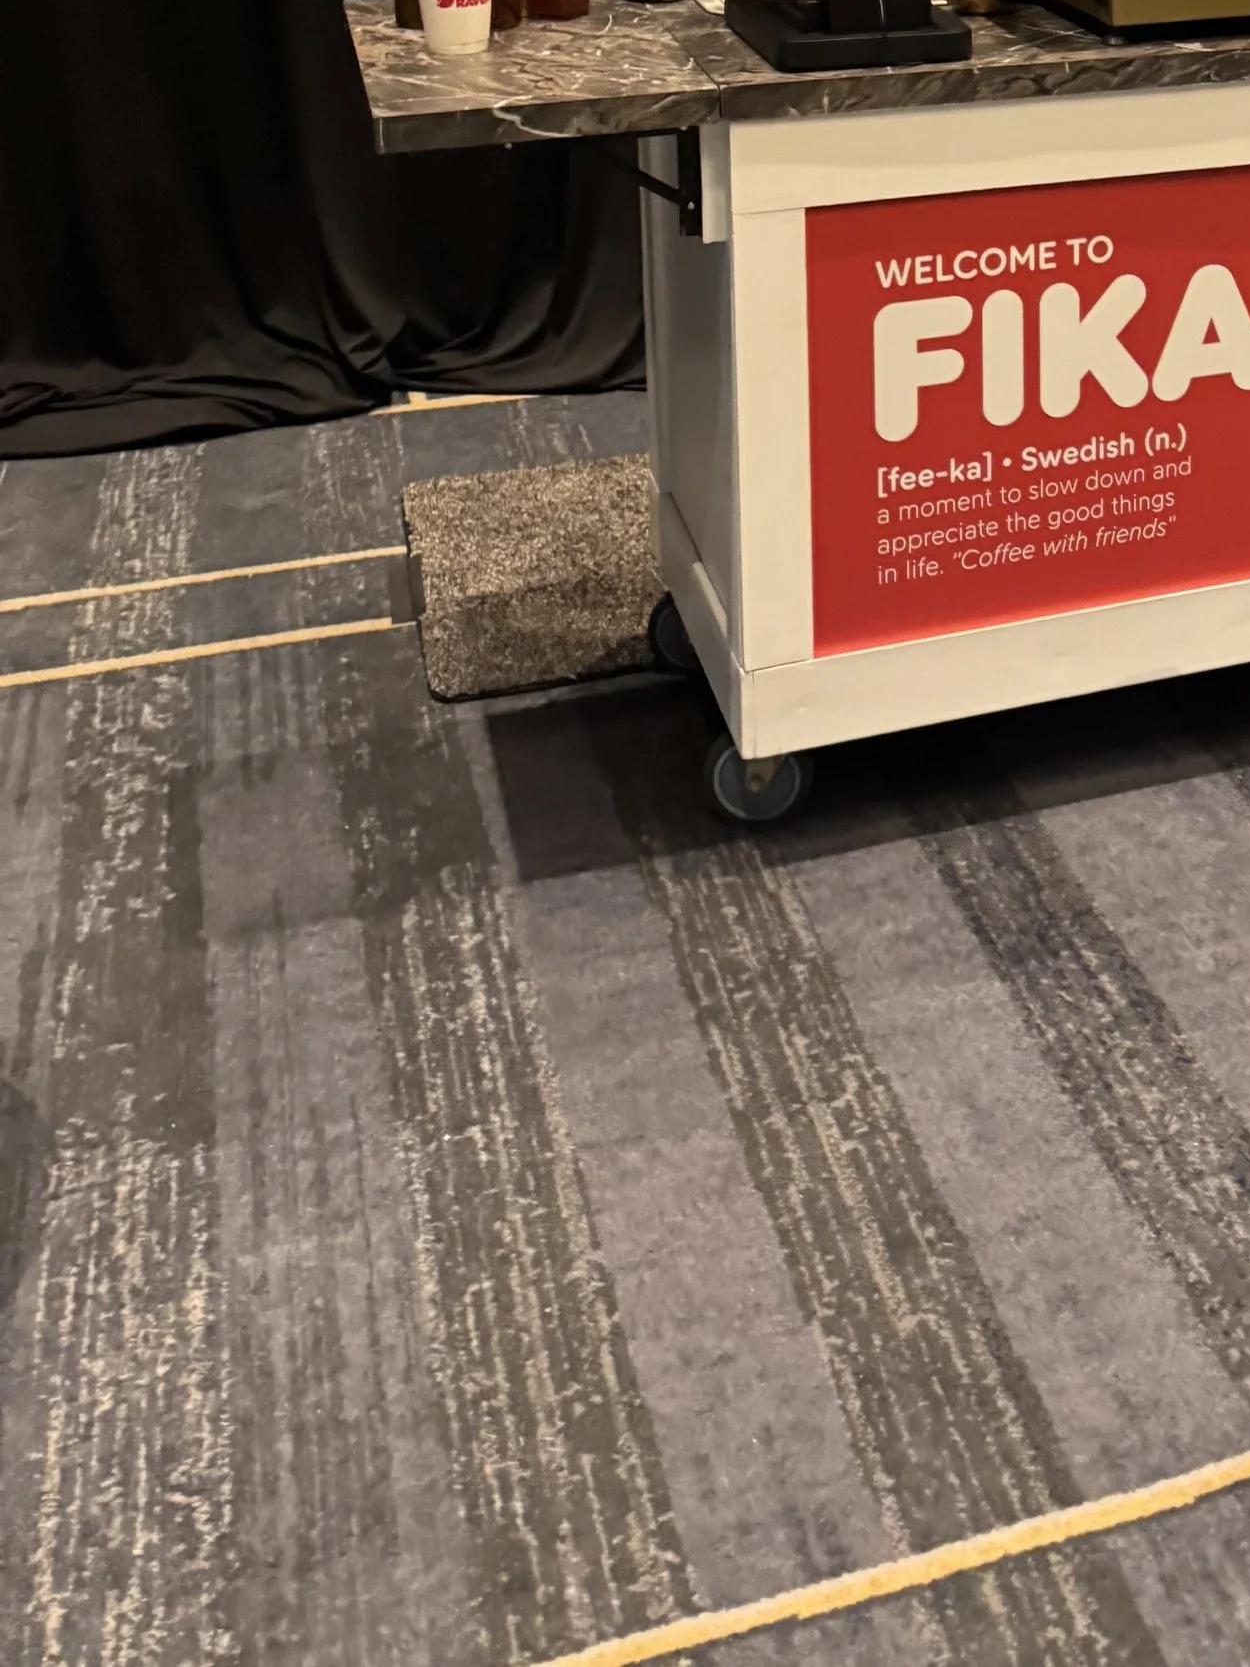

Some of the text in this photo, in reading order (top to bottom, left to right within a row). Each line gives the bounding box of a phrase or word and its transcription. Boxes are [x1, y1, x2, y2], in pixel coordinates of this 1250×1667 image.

[875, 235, 1114, 289] WELCOME TO
[877, 423, 1187, 498] [fee-ka] Swedish (n.)
[877, 455, 1192, 525] a moment to slow down and
[877, 489, 1175, 556] appreciate the good things
[877, 565, 897, 585] in
[906, 554, 944, 579] life.
[1043, 533, 1088, 557] with
